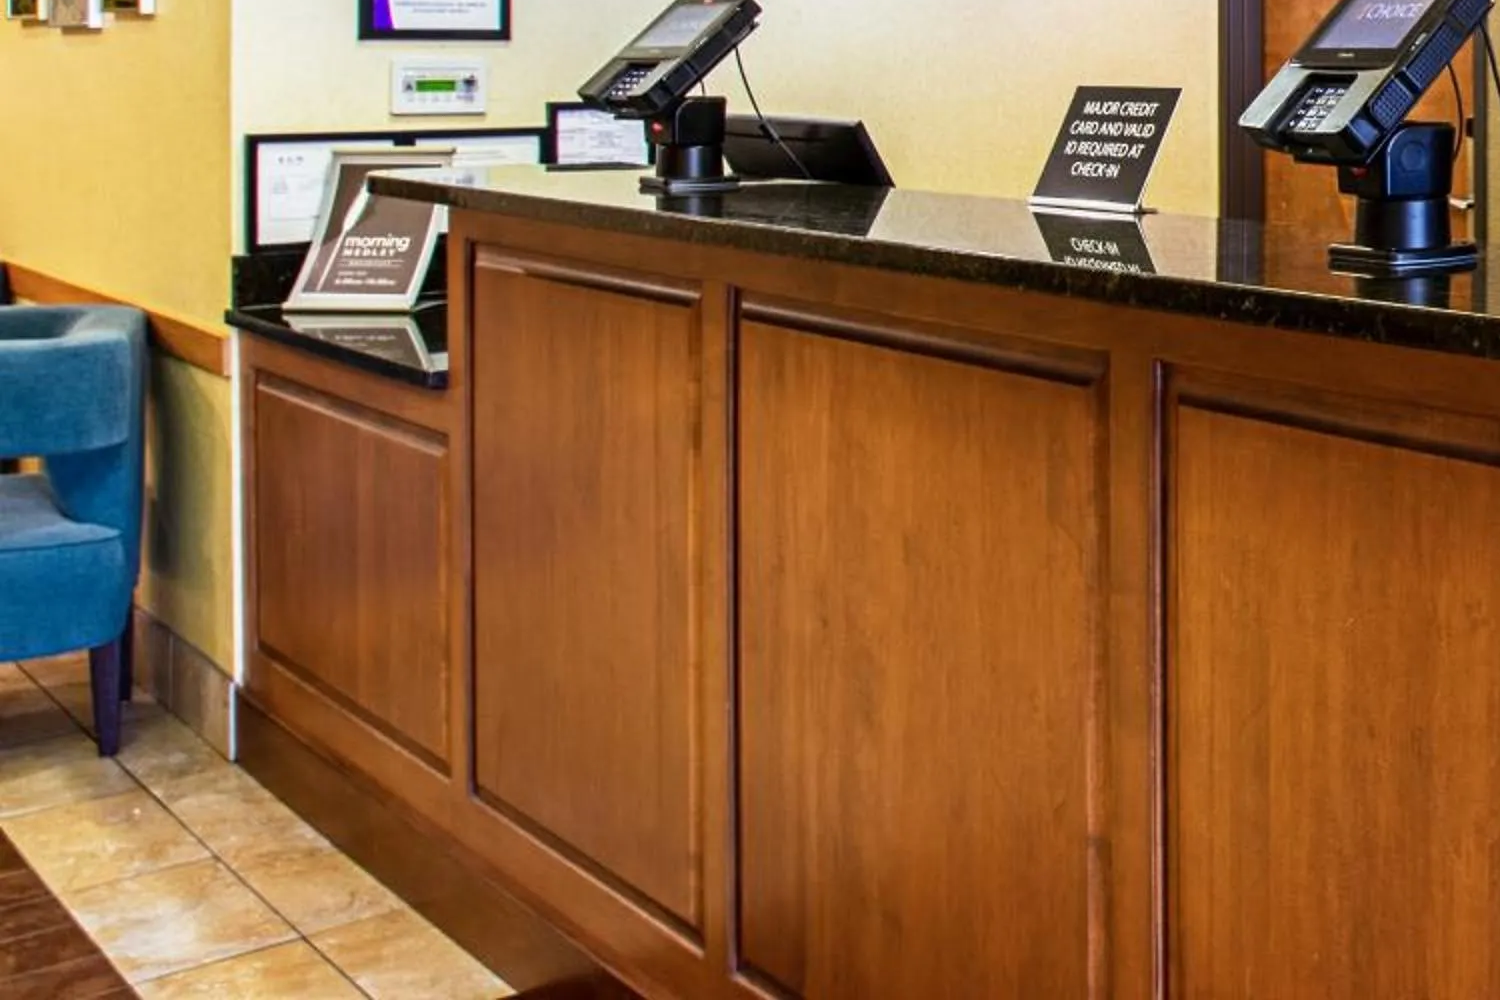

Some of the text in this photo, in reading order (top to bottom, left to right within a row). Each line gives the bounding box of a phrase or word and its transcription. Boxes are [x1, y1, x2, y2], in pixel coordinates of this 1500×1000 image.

[1083, 101, 1159, 117] MAJOR CREDIT
[1069, 120, 1156, 139] CARD AND VALID
[1064, 140, 1146, 160] ID REQUIRED AT
[1071, 161, 1121, 179] CHECK-IN
[344, 232, 412, 253] morning
[341, 247, 397, 257] MEDLEY
